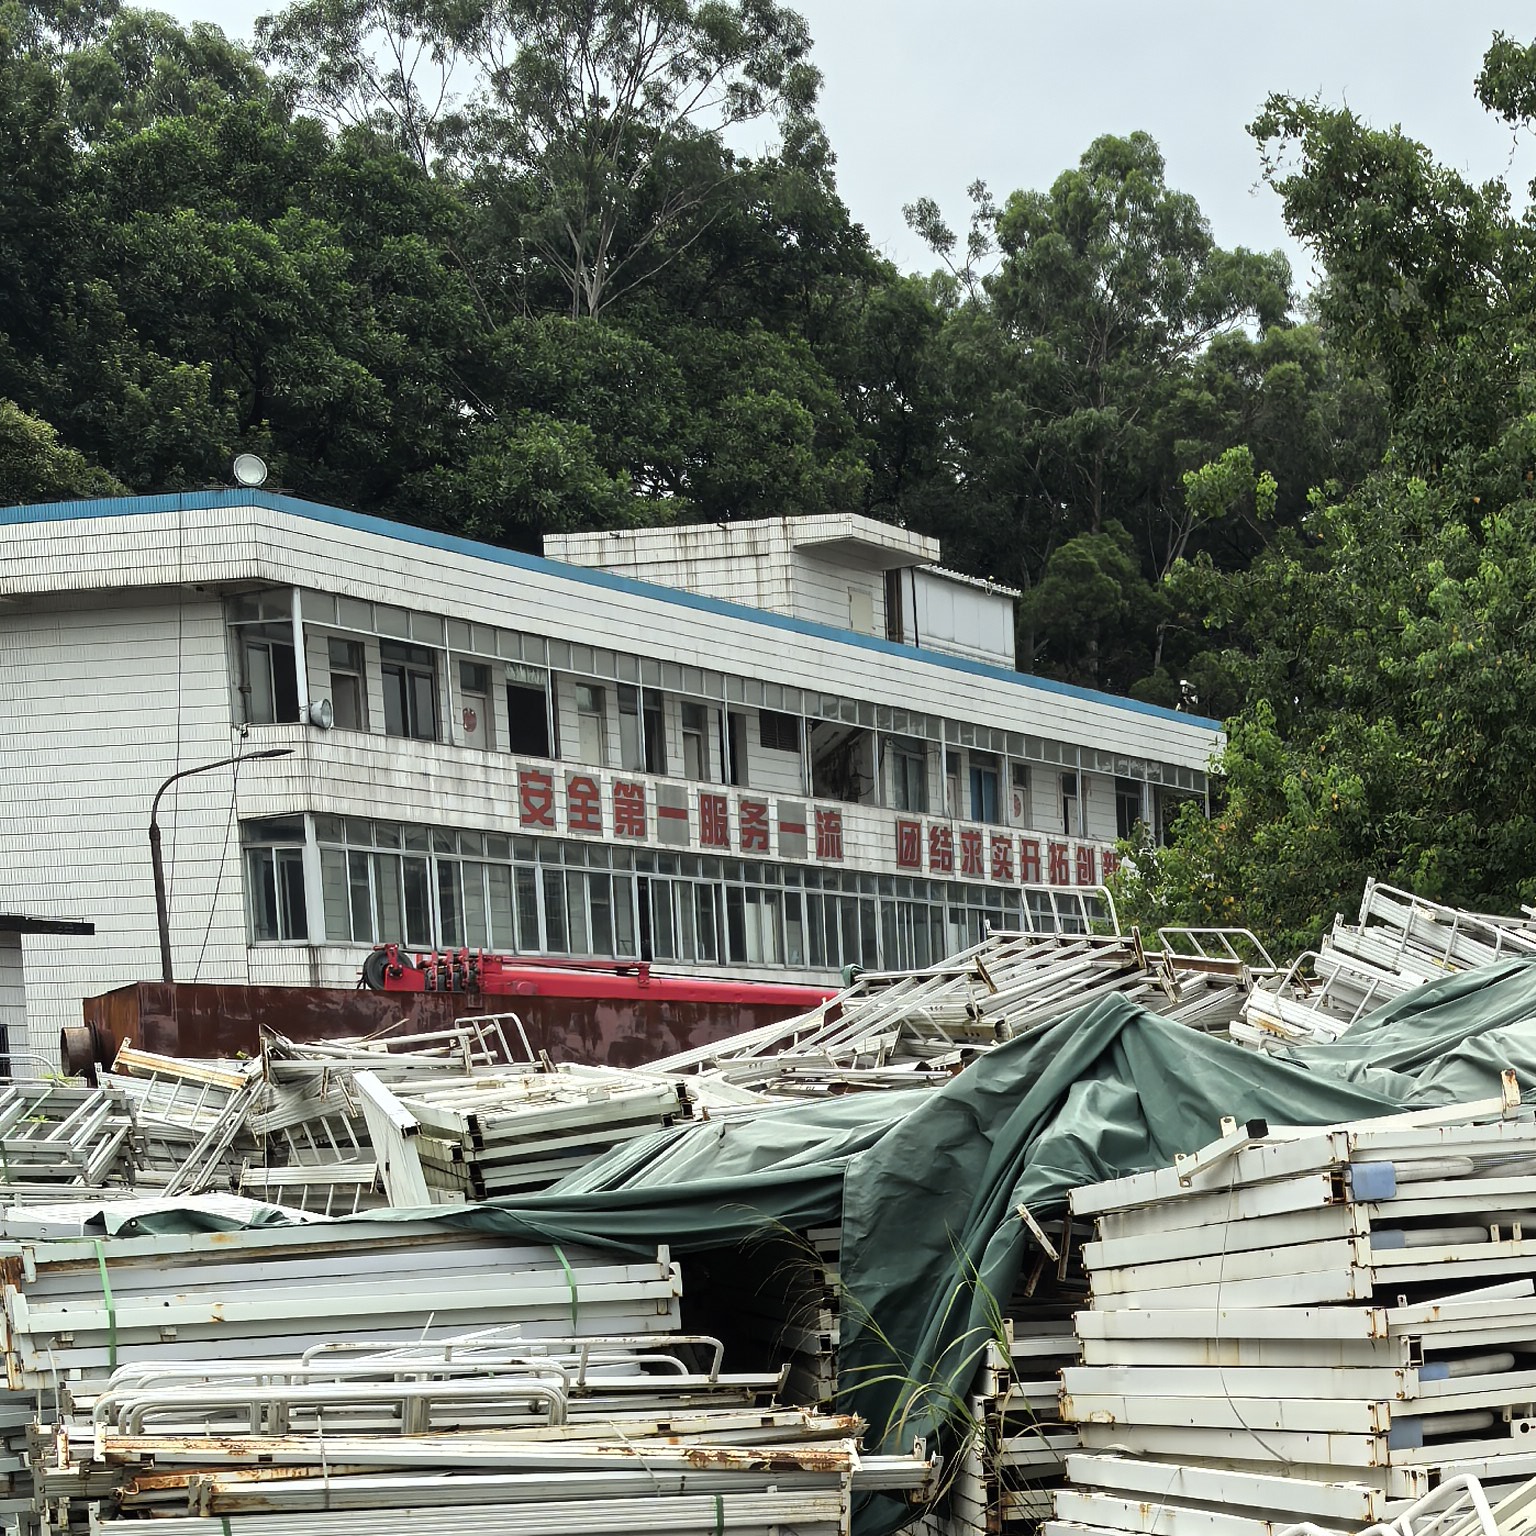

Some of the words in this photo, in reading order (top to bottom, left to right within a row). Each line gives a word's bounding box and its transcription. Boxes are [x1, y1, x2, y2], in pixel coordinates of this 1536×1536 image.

[519, 769, 843, 858] 安全第一服务一流
